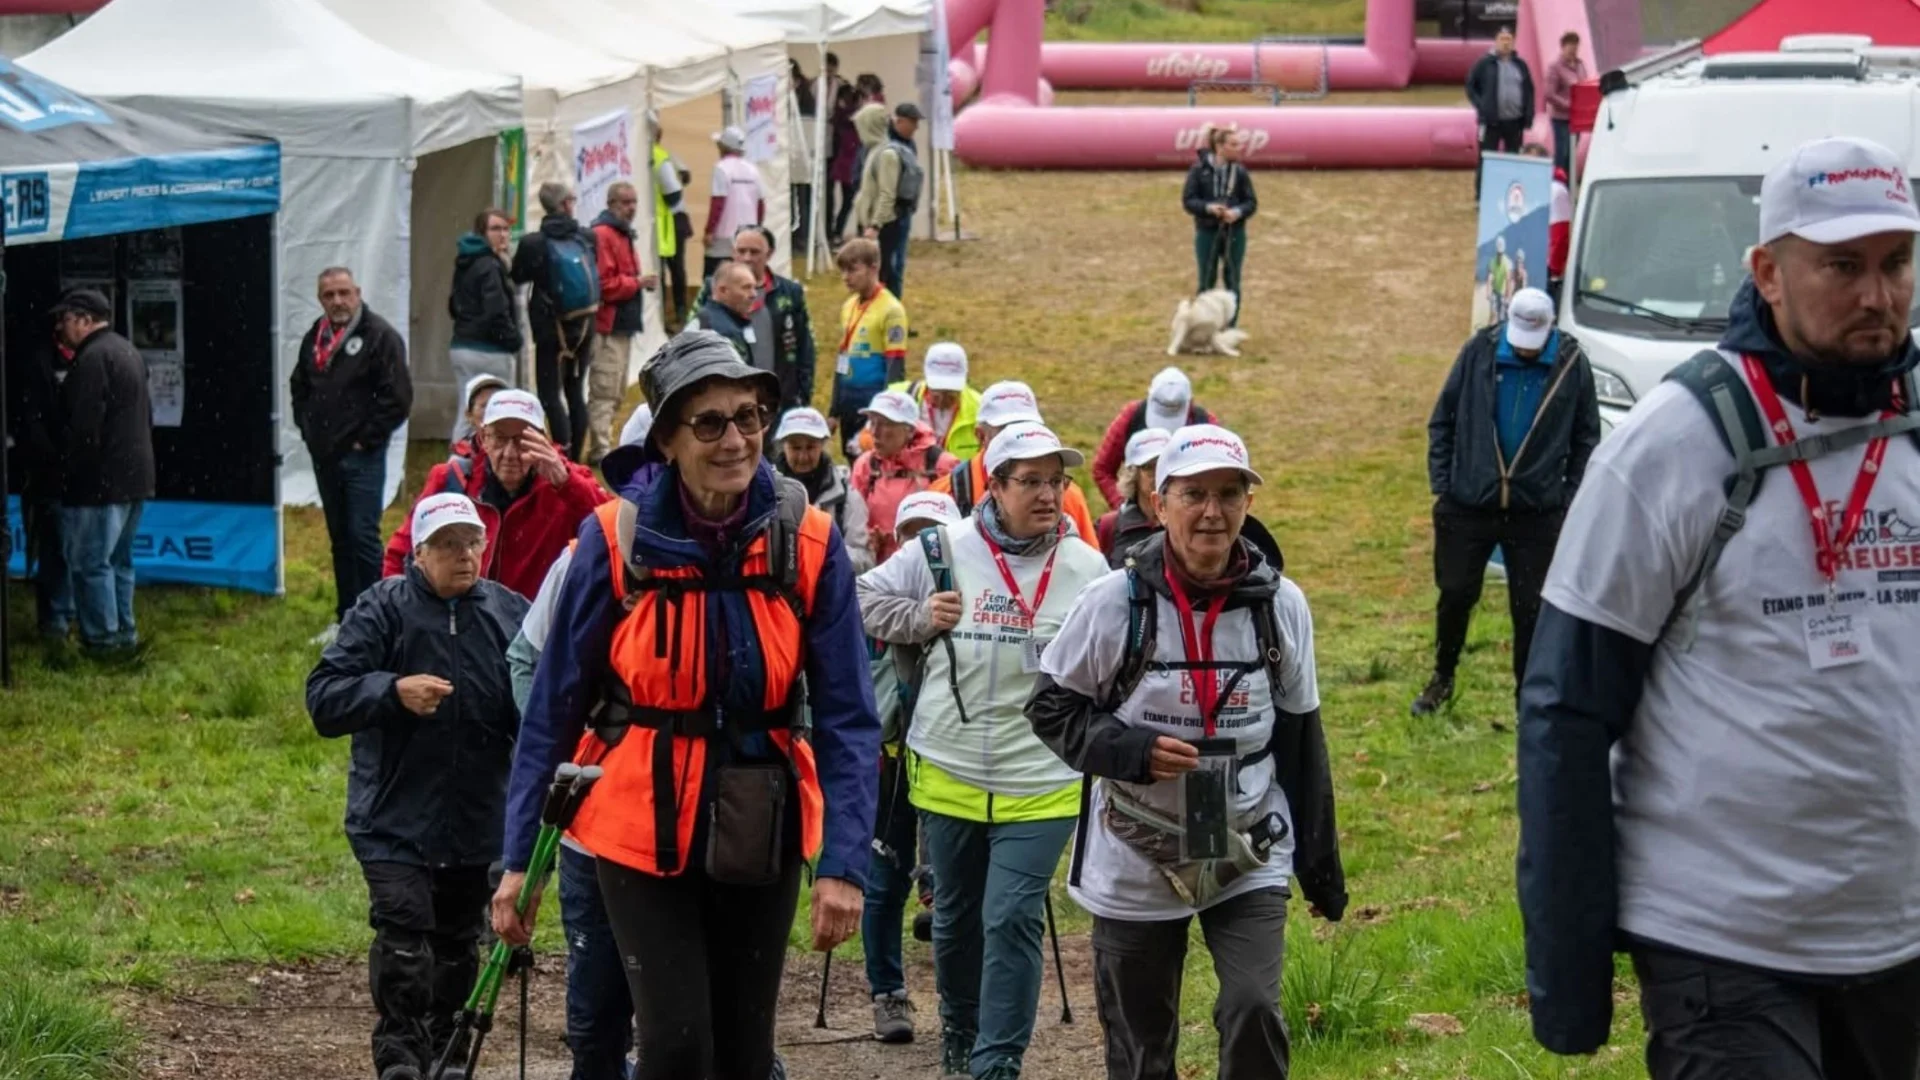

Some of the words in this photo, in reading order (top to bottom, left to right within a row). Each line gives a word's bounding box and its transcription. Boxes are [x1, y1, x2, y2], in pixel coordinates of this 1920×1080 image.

[1146, 51, 1230, 79] ufolep
[1174, 121, 1270, 157] ufep
[974, 598, 1006, 613] RANDO
[982, 588, 1007, 603] FESTI
[1762, 595, 1804, 616] ÉTANG
[1807, 593, 1826, 609] DU
[1877, 589, 1893, 605] LA
[972, 612, 1029, 627] CREUSE
